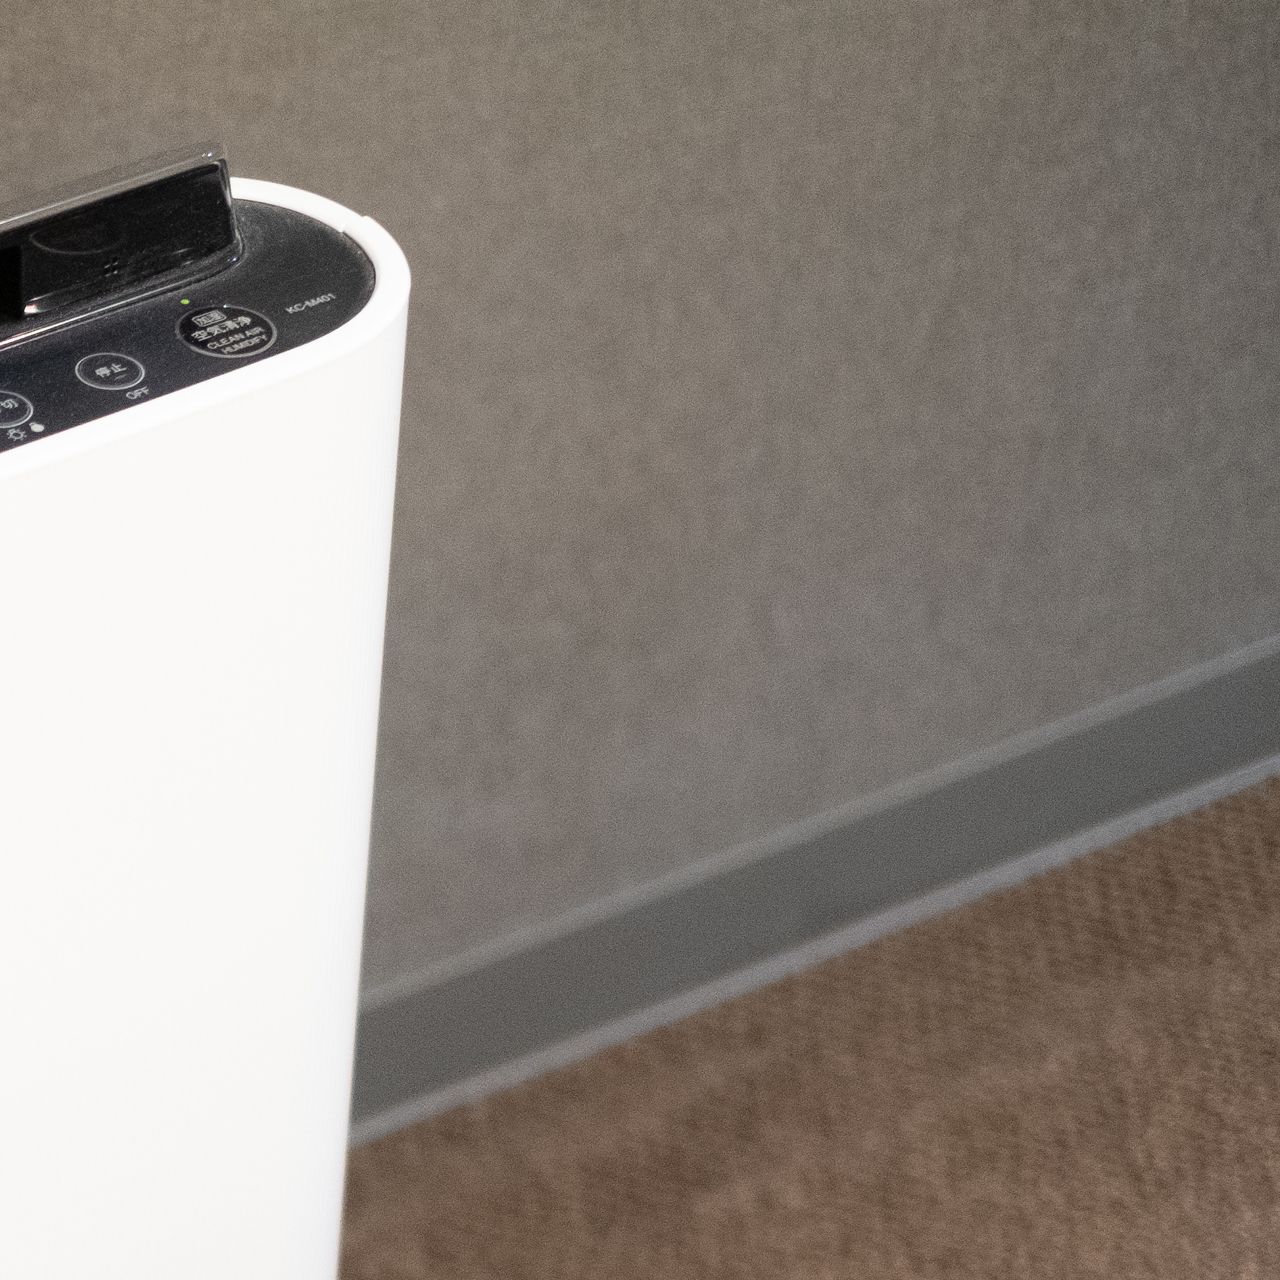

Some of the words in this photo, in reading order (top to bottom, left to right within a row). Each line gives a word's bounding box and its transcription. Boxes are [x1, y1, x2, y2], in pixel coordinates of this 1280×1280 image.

[207, 333, 245, 349] CLEAN
[244, 327, 264, 338] AIR
[221, 335, 268, 354] HUMIDIFY
[94, 363, 128, 378] 停止
[125, 387, 150, 399] OFF
